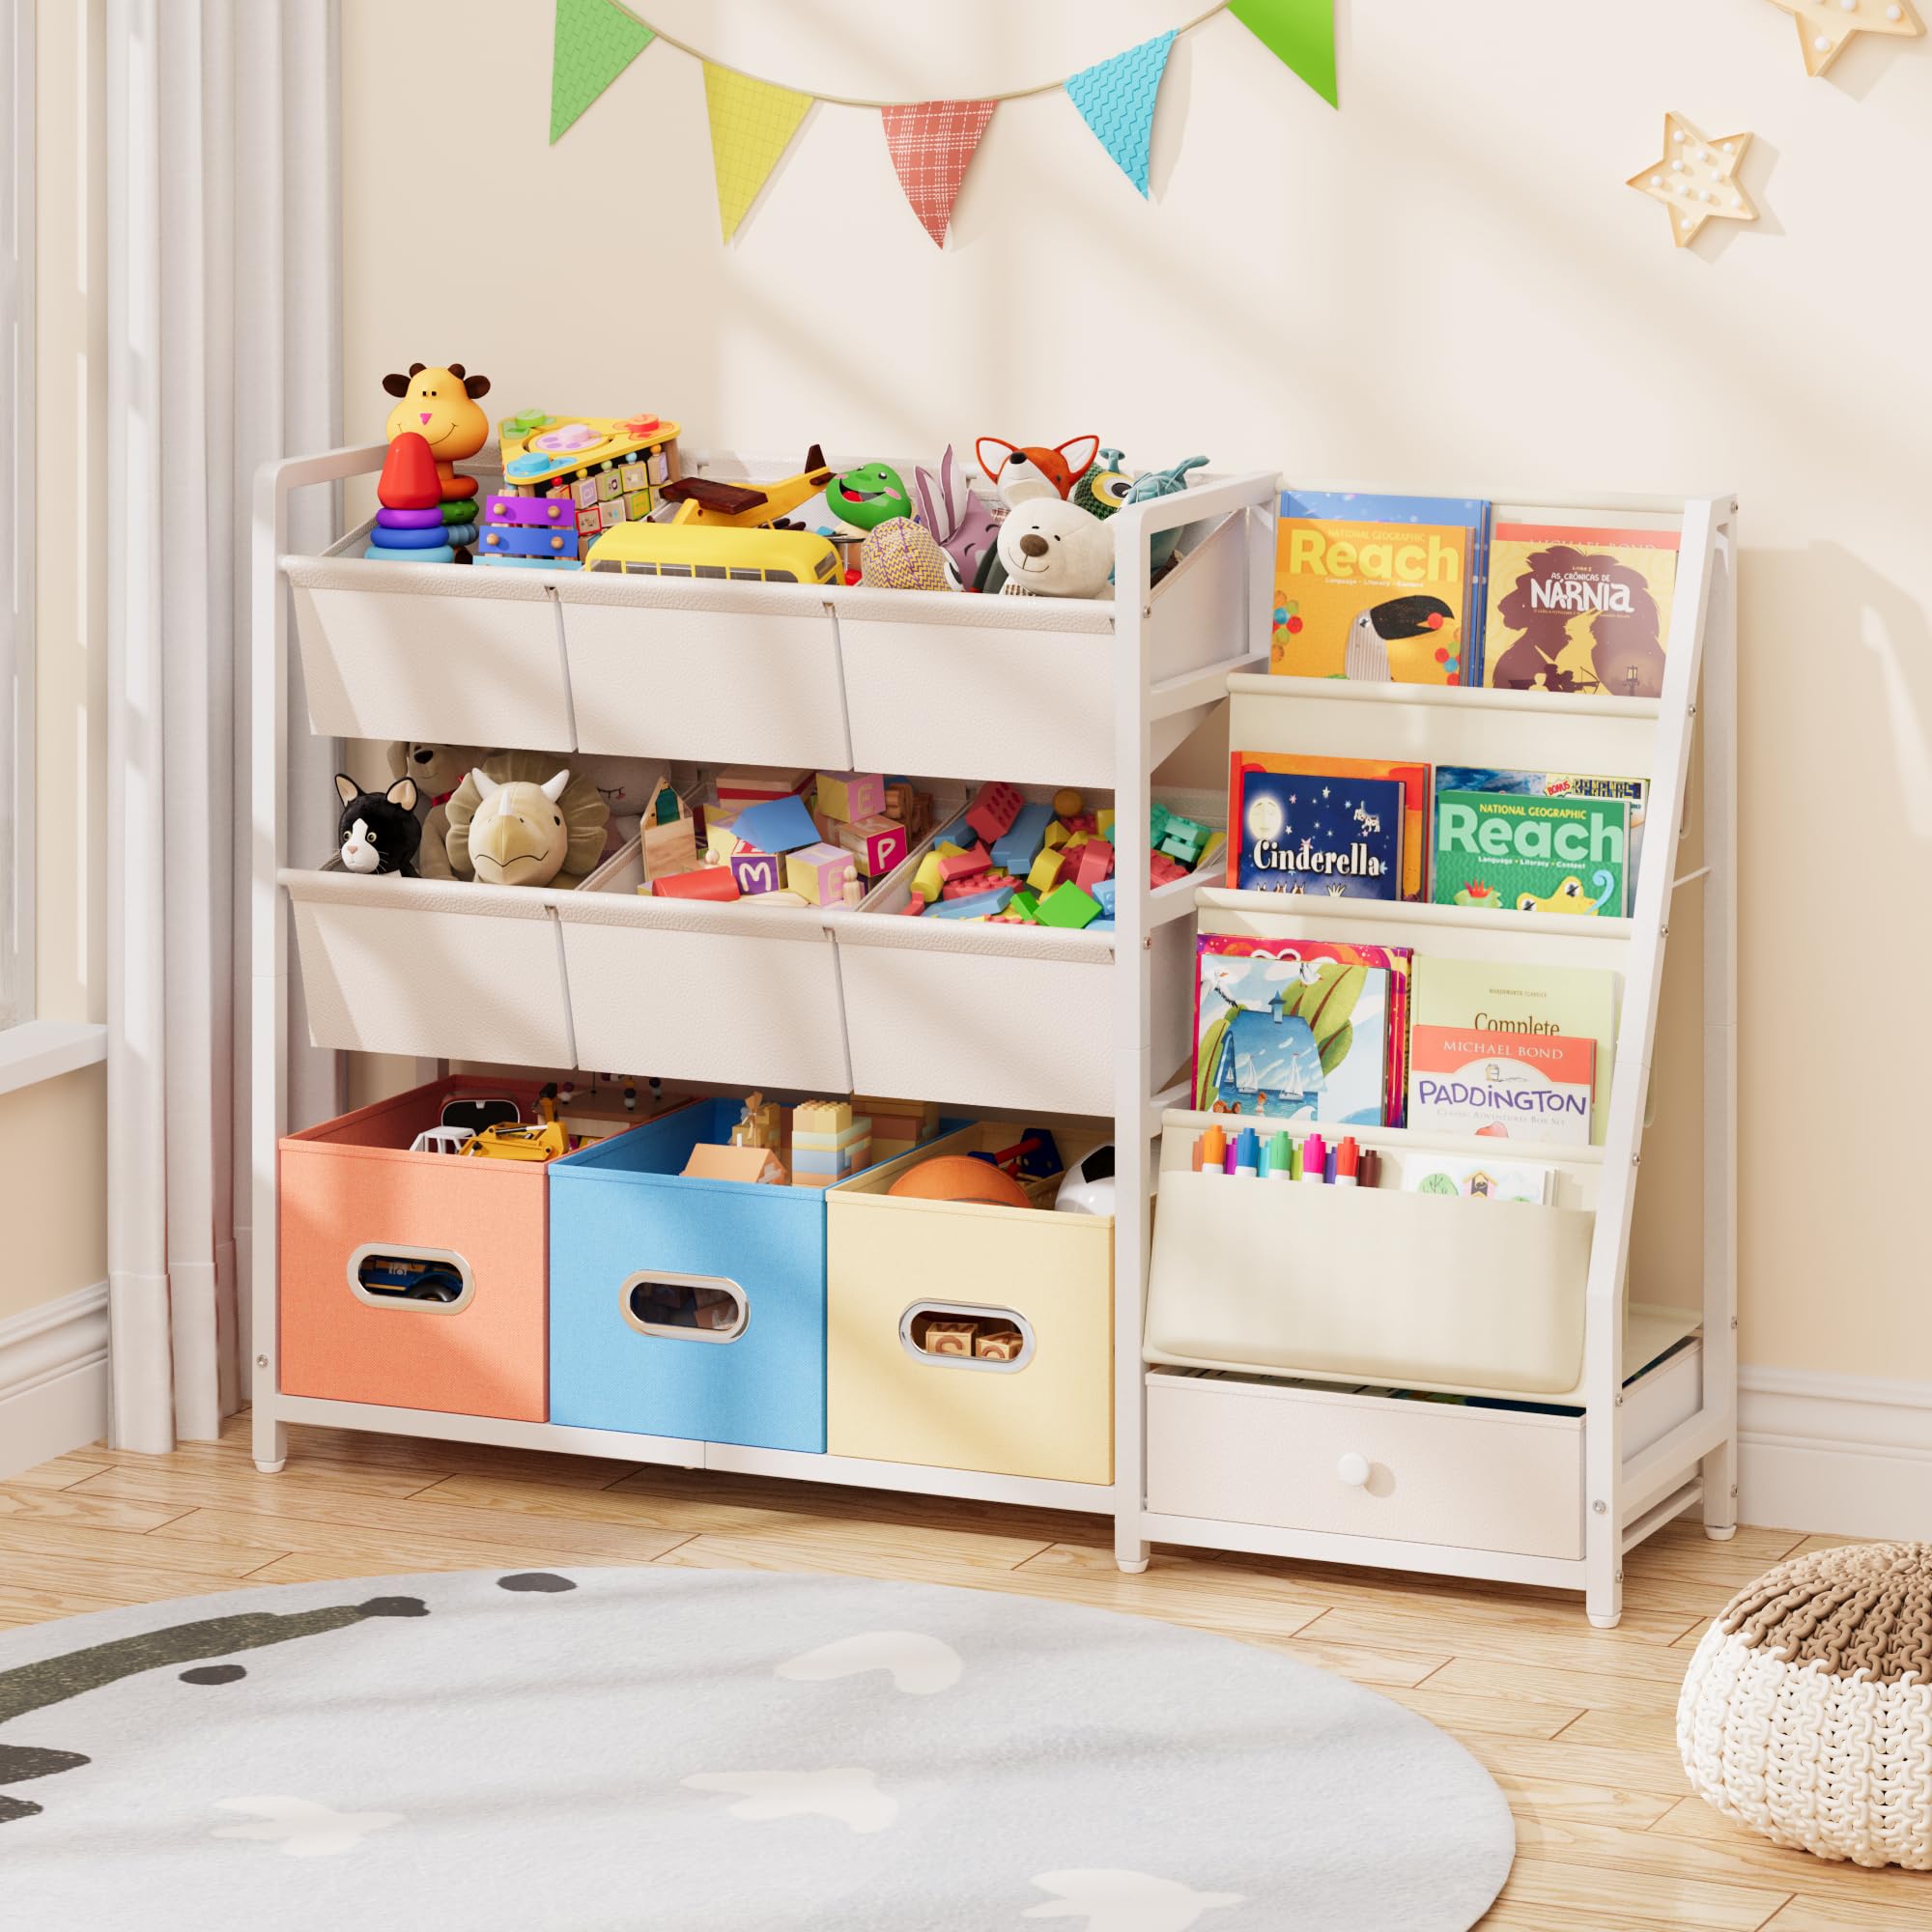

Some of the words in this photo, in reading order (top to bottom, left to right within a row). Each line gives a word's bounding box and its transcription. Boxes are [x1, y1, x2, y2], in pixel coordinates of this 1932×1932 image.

[1290, 527, 1460, 583] Reach
[1563, 571, 1600, 582] CRÔNICAS
[1602, 574, 1611, 582] DE
[1547, 779, 1572, 796] BONUS
[1479, 804, 1526, 816] NATIONAL
[1528, 806, 1587, 820] GEOGRAPHIC
[1438, 803, 1624, 864] Reach
[877, 838, 896, 869] P
[1253, 838, 1380, 877] Cinderella
[1478, 856, 1513, 866] Language
[1520, 859, 1550, 868] Literacy
[1556, 861, 1586, 869] Content
[738, 862, 772, 892] M
[1474, 1012, 1560, 1037] Complete
[1443, 1040, 1513, 1056] MICHAEL
[1519, 1045, 1564, 1060] BOND
